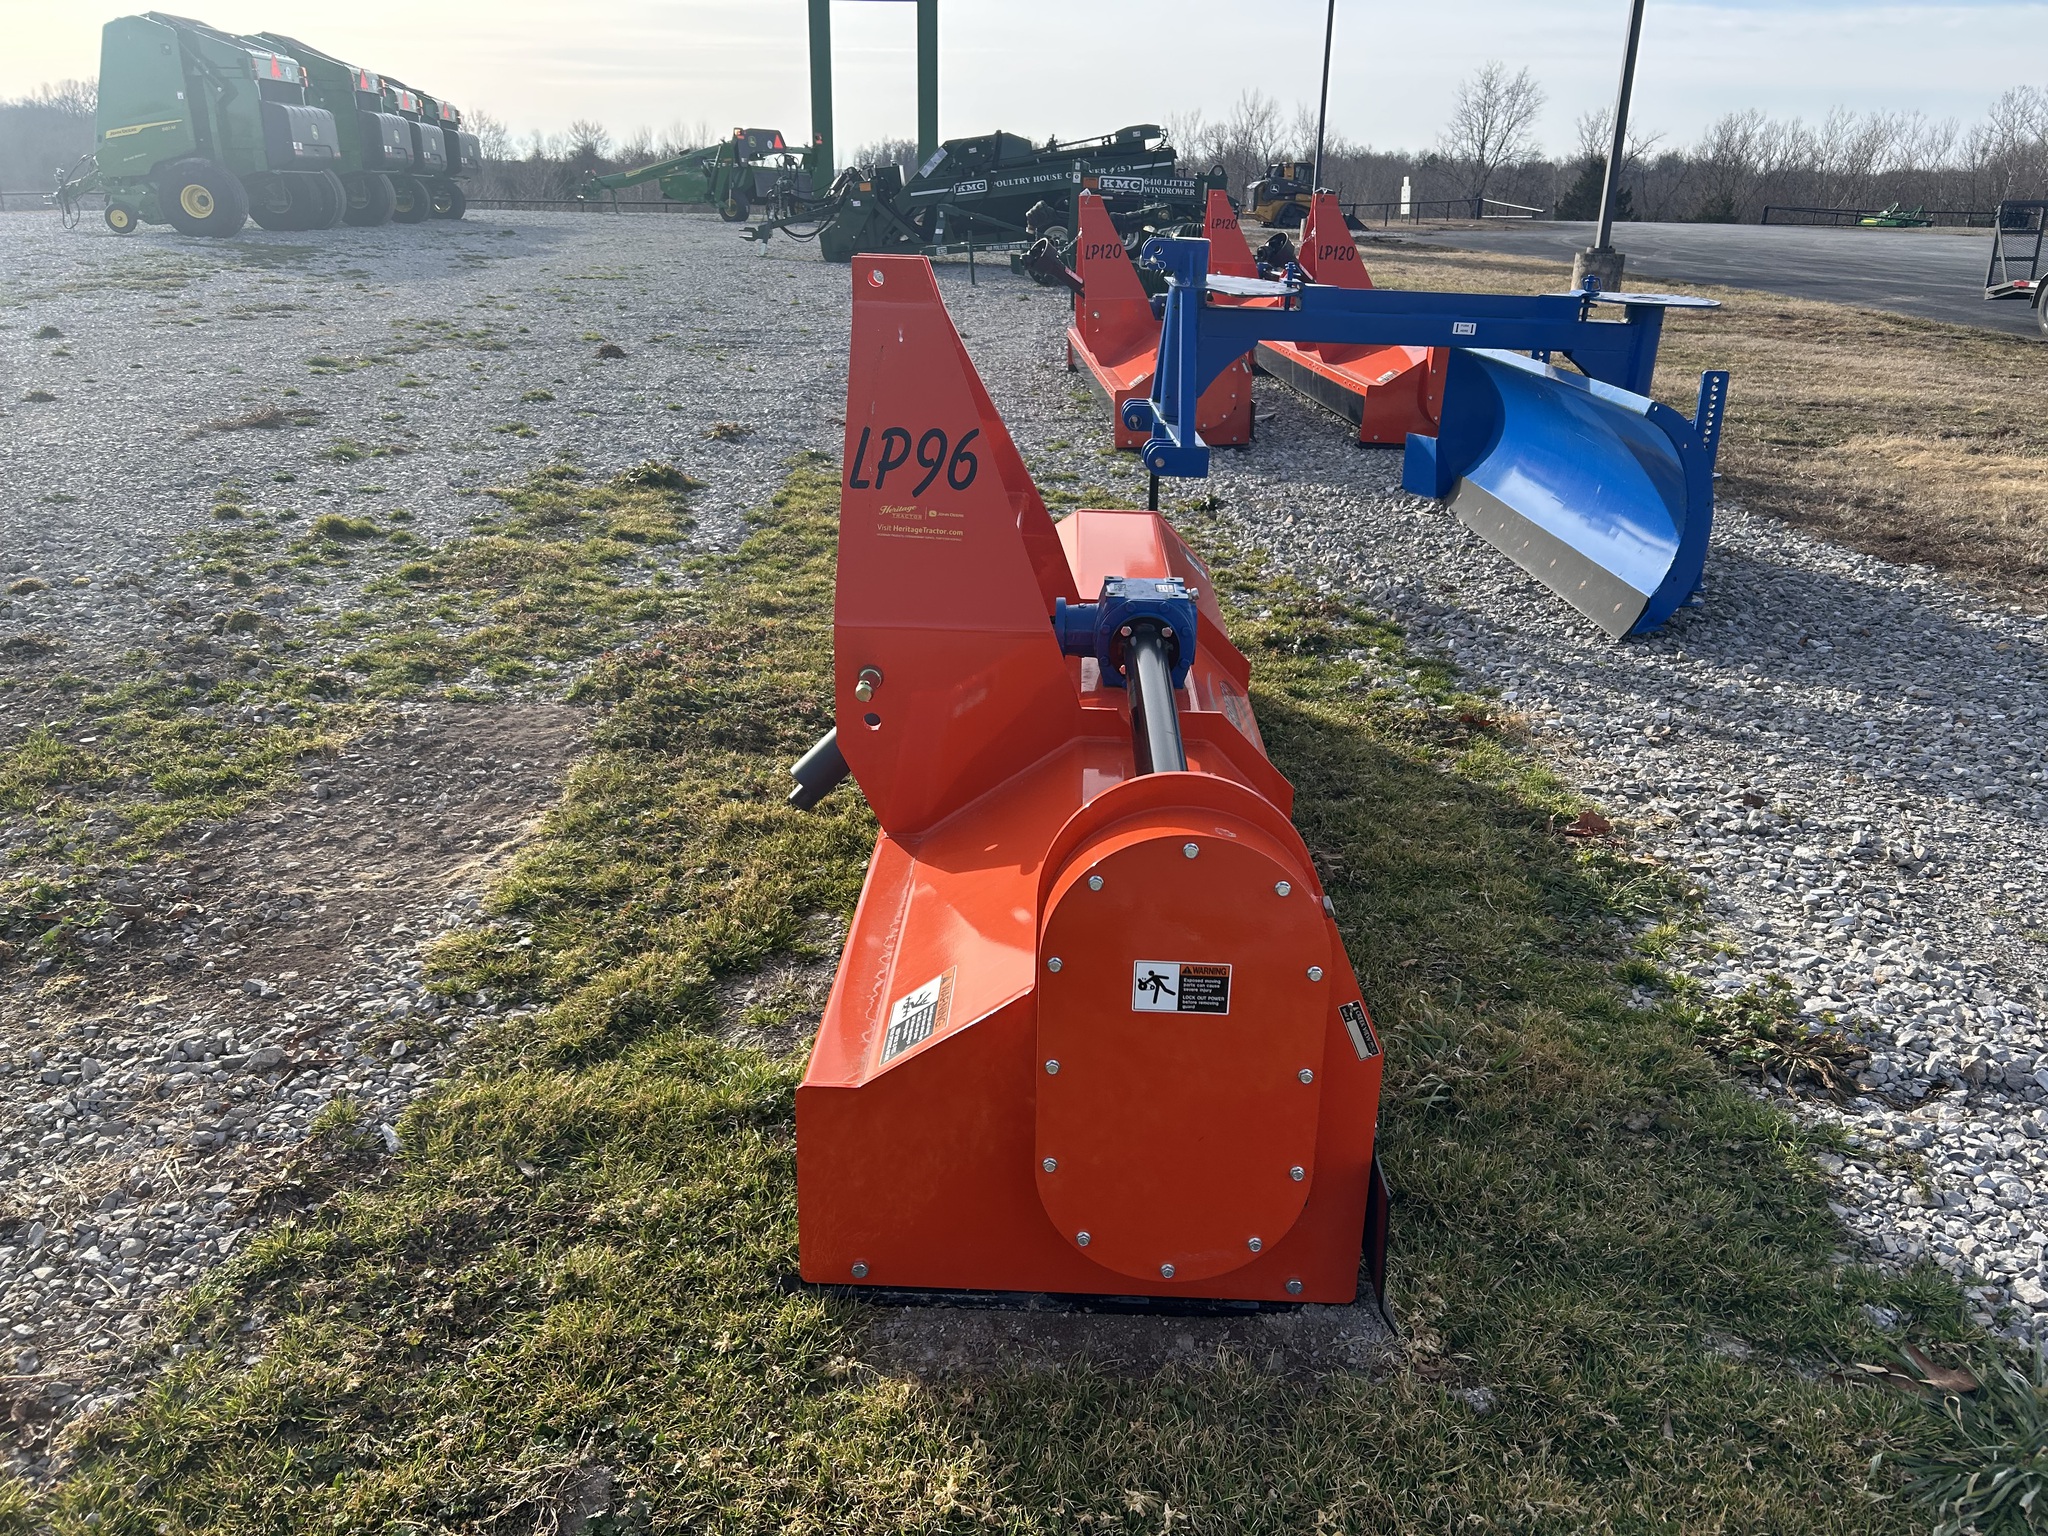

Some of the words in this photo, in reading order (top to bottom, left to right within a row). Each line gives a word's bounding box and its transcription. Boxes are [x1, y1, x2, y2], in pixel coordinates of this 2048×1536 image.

[1033, 172, 1063, 182] HOUSE
[957, 182, 984, 193] KMC
[1102, 179, 1141, 190] KMC
[1144, 178, 1162, 186] 6410
[1164, 179, 1196, 188] LITTER
[1144, 186, 1196, 196] WINDROWER
[1211, 217, 1238, 230] LP120
[1085, 243, 1122, 261] LP120
[1318, 244, 1355, 261] LP120
[850, 426, 980, 498] LP96
[879, 504, 917, 515] Heritage
[877, 523, 892, 532] Visit
[893, 525, 964, 536] HeritageTractor.com
[1192, 966, 1227, 976] WARNING
[935, 982, 951, 1028] WARNING
